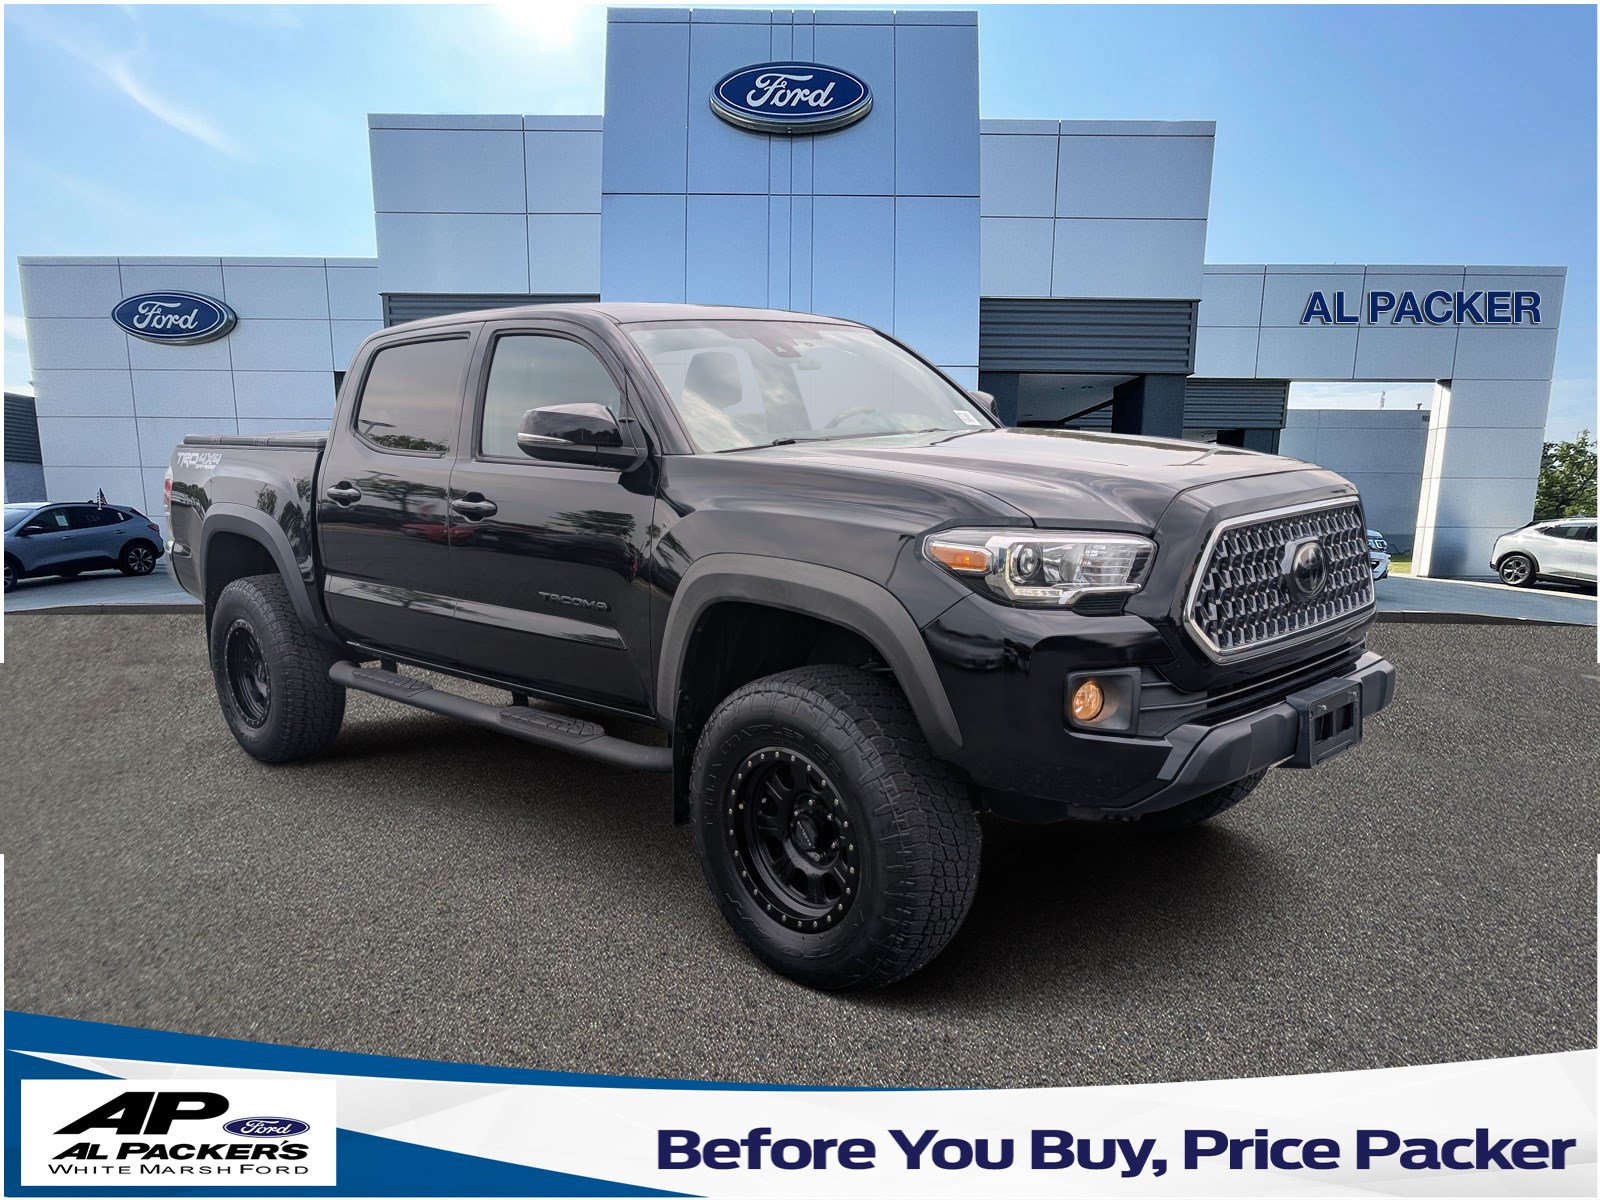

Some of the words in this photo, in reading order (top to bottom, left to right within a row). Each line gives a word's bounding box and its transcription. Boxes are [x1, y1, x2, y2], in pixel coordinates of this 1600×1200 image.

[746, 73, 836, 108] Ford
[132, 301, 199, 329] Ford
[1302, 291, 1360, 324] AL
[1368, 290, 1542, 324] PACKER
[538, 591, 609, 610] TACOMA
